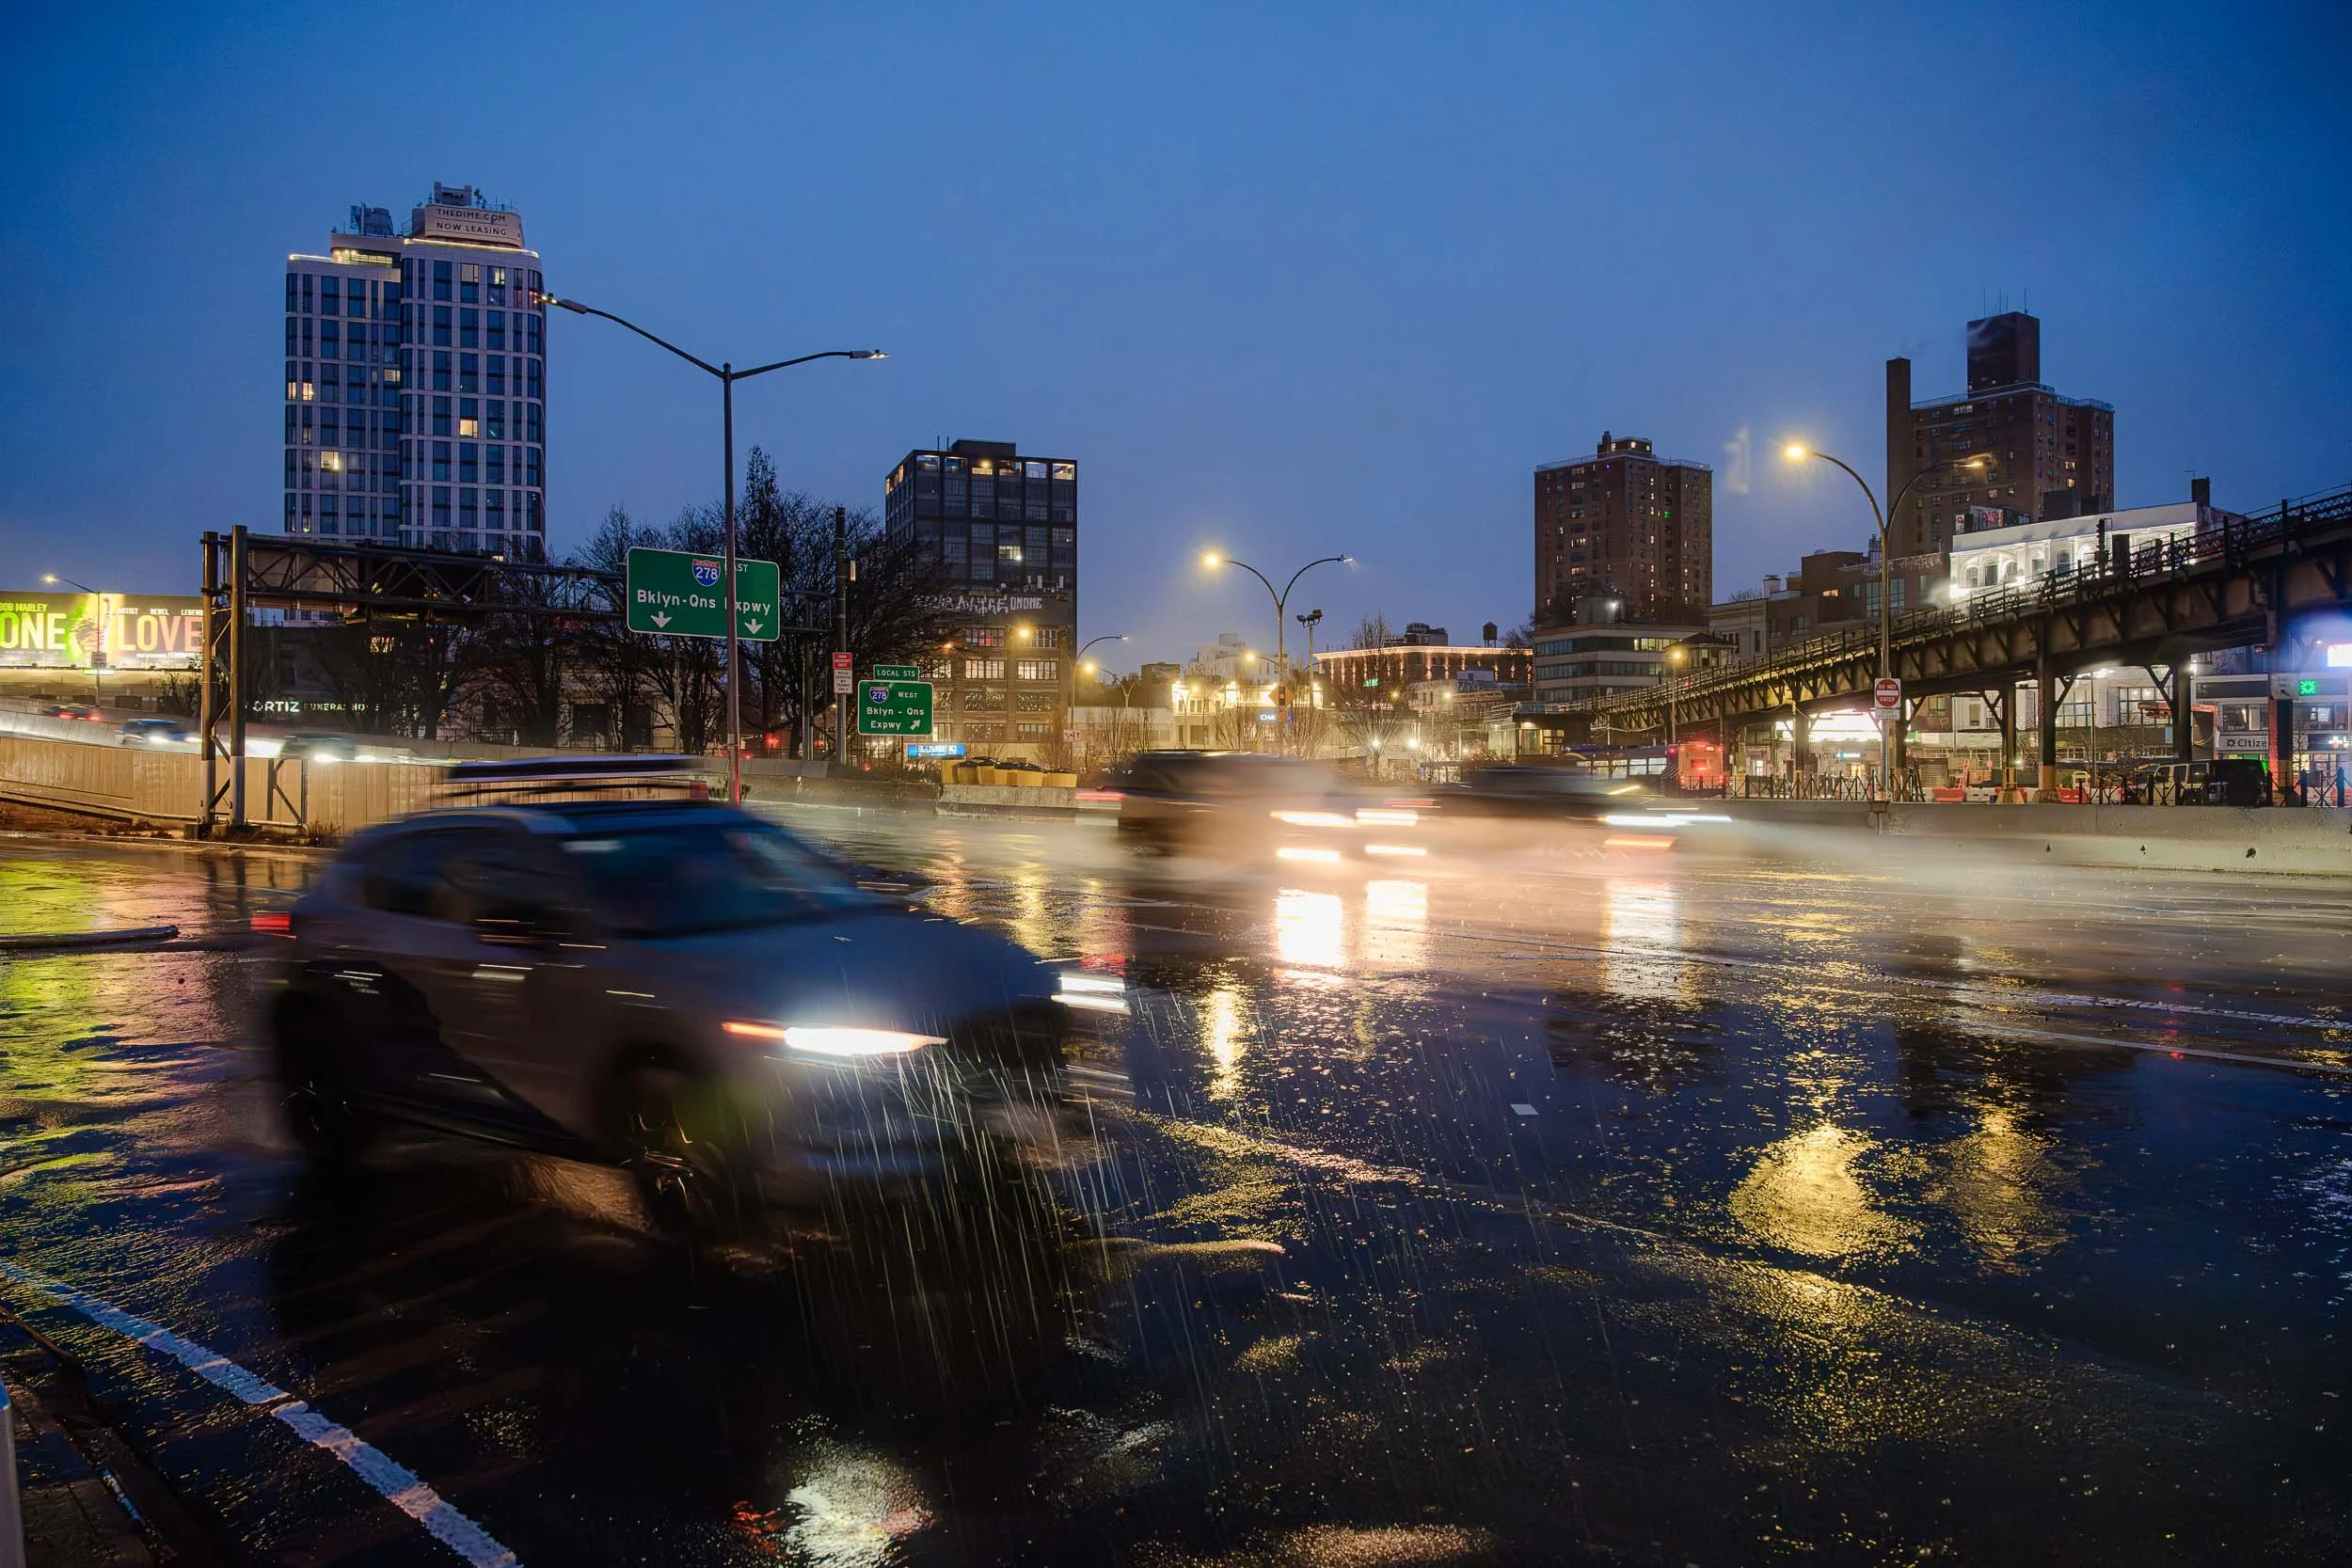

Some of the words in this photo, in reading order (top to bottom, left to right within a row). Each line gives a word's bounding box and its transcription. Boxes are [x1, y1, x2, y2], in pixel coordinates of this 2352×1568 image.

[437, 209, 505, 222] THEDIME.COM
[437, 222, 461, 231] NOW
[466, 225, 506, 235] LEASING
[695, 566, 718, 579] 278
[15, 603, 47, 611] MARLEY
[637, 589, 716, 609] Bklyn-Qns
[724, 596, 771, 616] xpwy
[0, 611, 67, 649] ONE
[117, 613, 204, 652] LOVE
[872, 691, 887, 700] 278
[252, 701, 300, 712] ORTIZ
[866, 707, 894, 716] Bklyn
[870, 721, 901, 730] Expwy
